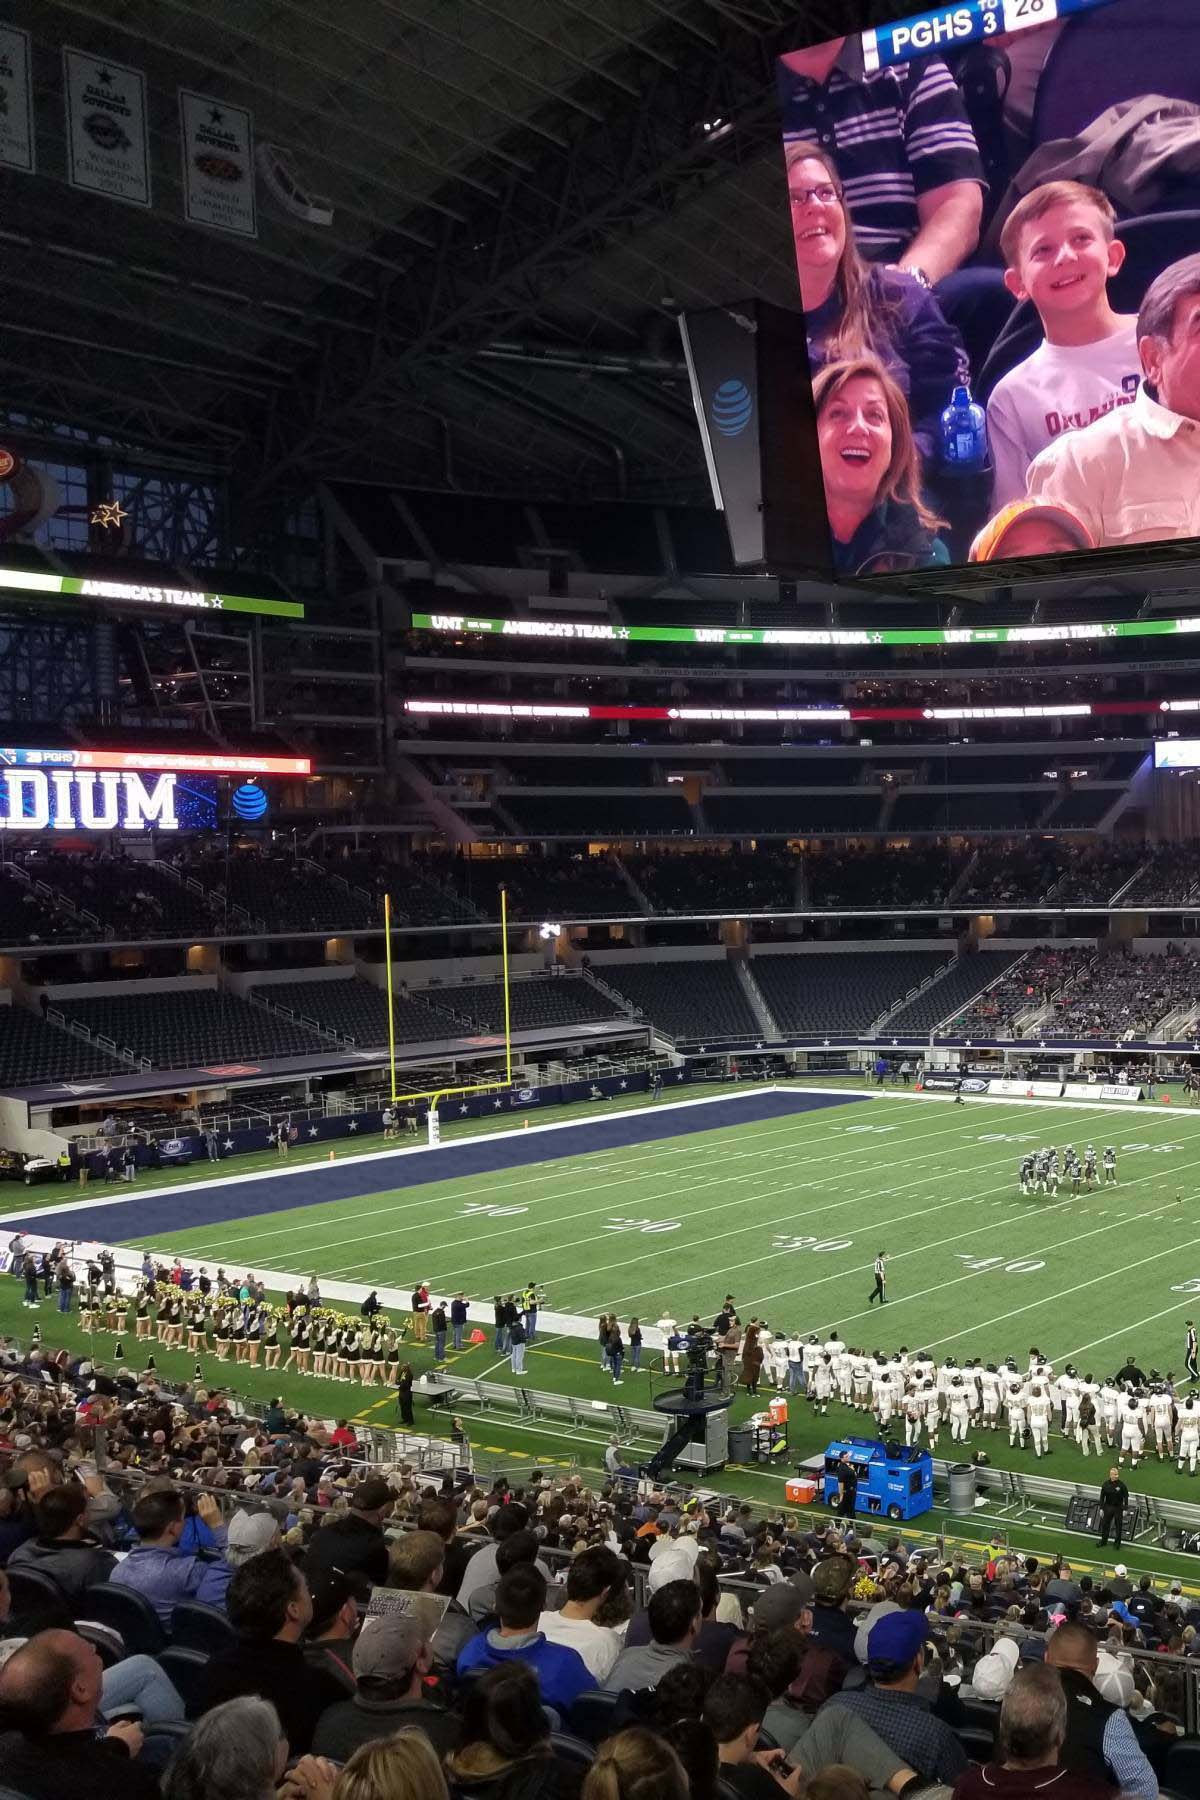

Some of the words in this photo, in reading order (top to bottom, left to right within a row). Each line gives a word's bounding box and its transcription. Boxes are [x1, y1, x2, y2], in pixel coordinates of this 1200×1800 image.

[891, 9, 973, 54] PGHS
[983, 12, 997, 33] 3
[81, 579, 163, 602] AMERICA'S
[502, 621, 574, 637] AMERICA'S
[43, 752, 73, 763] PGHS
[0, 769, 179, 830] DIUM
[962, 1256, 1046, 1273] 40
